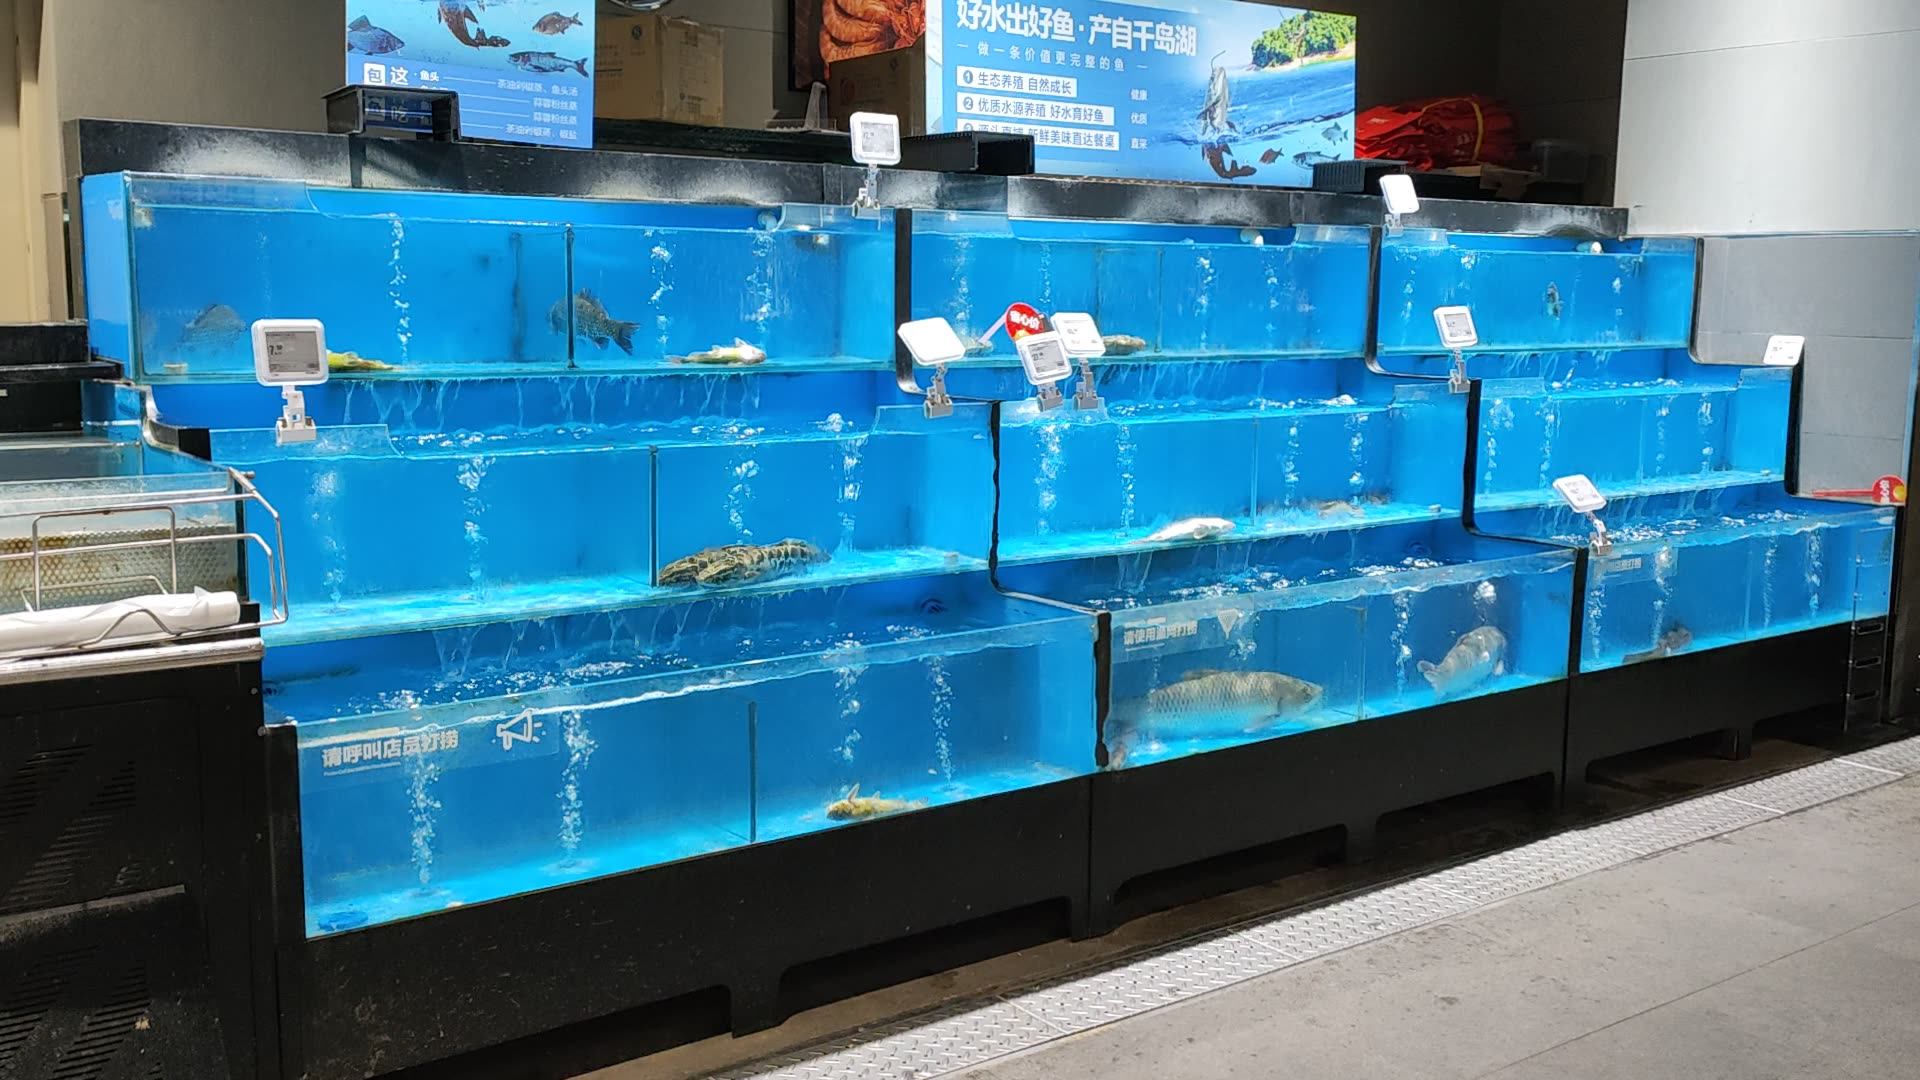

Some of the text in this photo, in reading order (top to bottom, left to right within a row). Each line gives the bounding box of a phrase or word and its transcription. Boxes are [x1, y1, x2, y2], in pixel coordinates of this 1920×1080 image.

[977, 71, 1024, 90] 生态养殖
[1028, 77, 1073, 95] 自然成长
[978, 97, 1046, 117] 优质水源养殖
[1050, 107, 1105, 123] 好水育好鱼
[322, 731, 458, 767] 请呼叫店员打捞
